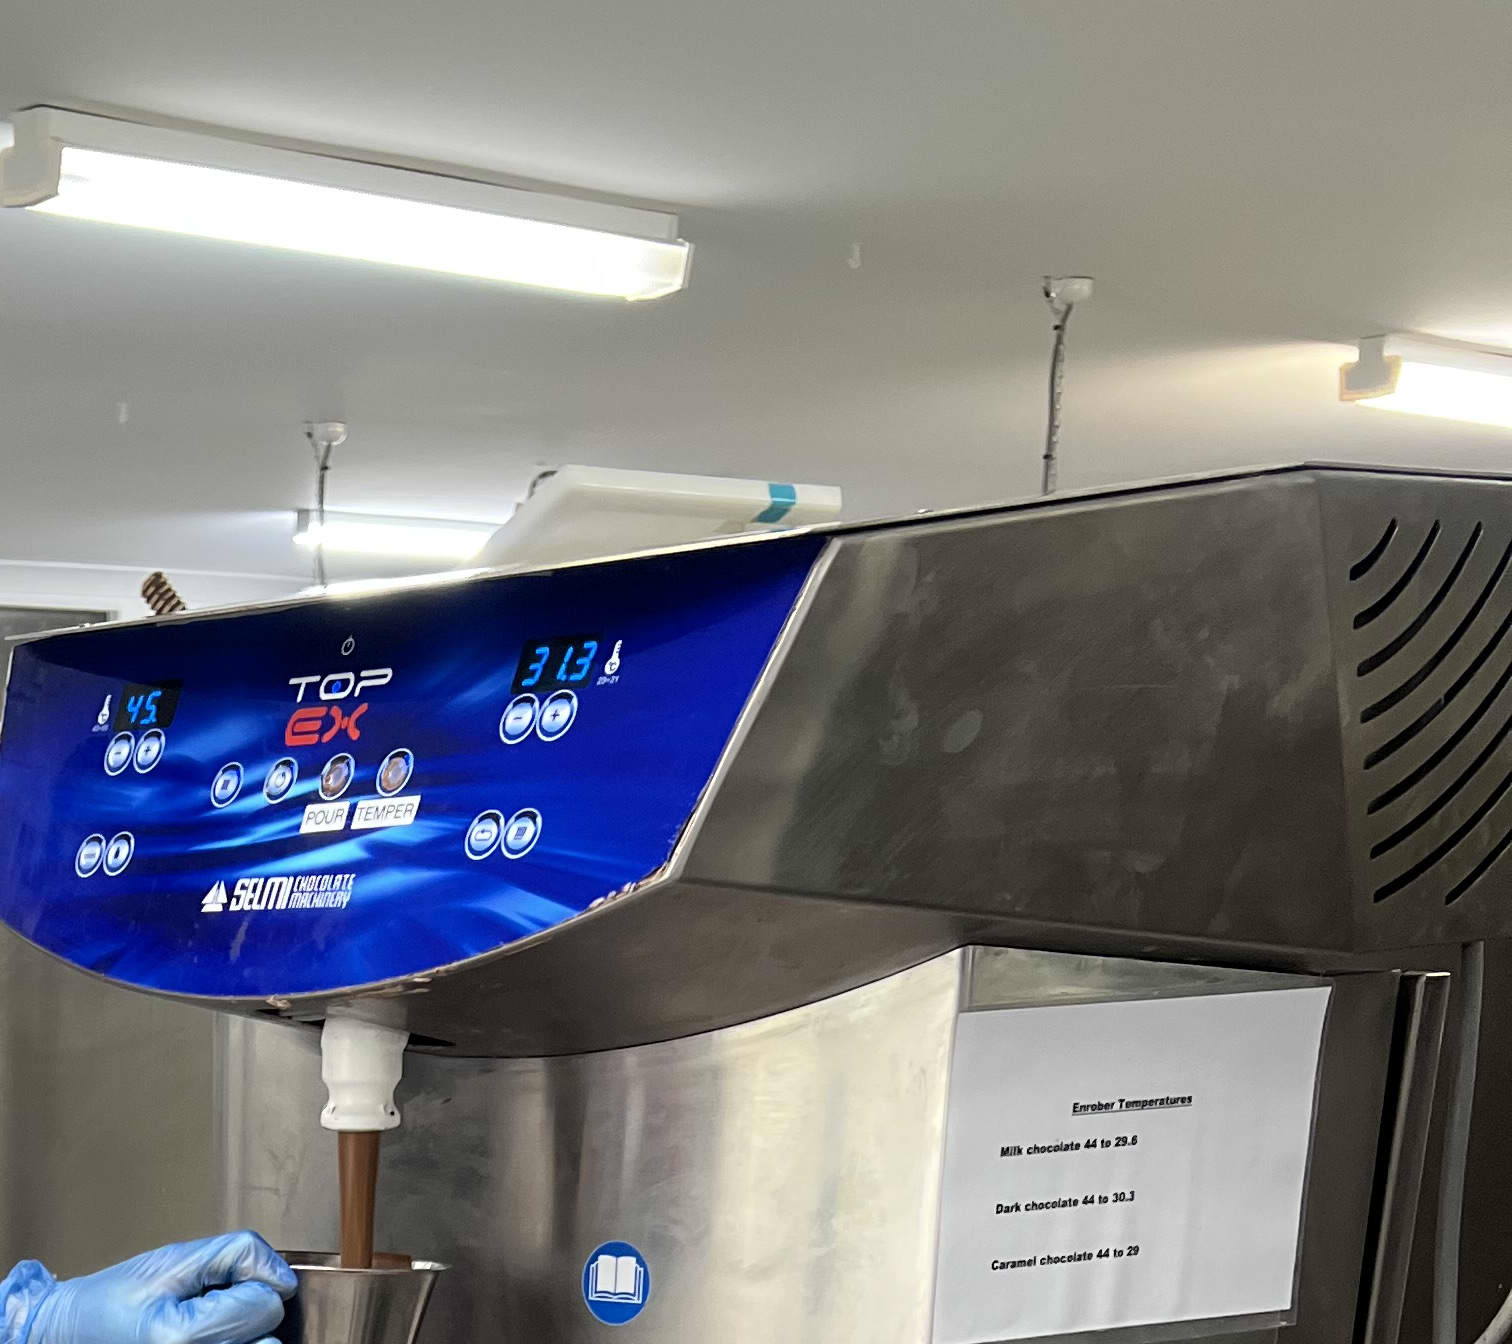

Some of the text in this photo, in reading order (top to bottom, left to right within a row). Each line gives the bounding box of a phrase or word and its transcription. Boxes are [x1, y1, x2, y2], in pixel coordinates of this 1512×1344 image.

[522, 640, 598, 687] 31.3
[288, 668, 393, 703] TOP
[285, 703, 369, 747] EX
[305, 808, 345, 826] POUR
[357, 802, 415, 822] TEMPER
[294, 873, 356, 892] CHOCOLATE
[229, 876, 294, 912] SELMI
[288, 891, 353, 910] MACHINERY
[1071, 1094, 1194, 1115] Enrober Temperatures
[1000, 1144, 1023, 1157] Milk
[1026, 1141, 1081, 1155] chocolate
[1084, 1138, 1097, 1149] 44
[1100, 1138, 1112, 1148] to
[995, 1190, 1135, 1214] Dark chocolate 44 to 30.3
[991, 1245, 1140, 1270] Caramel chocolate 44 to 29
